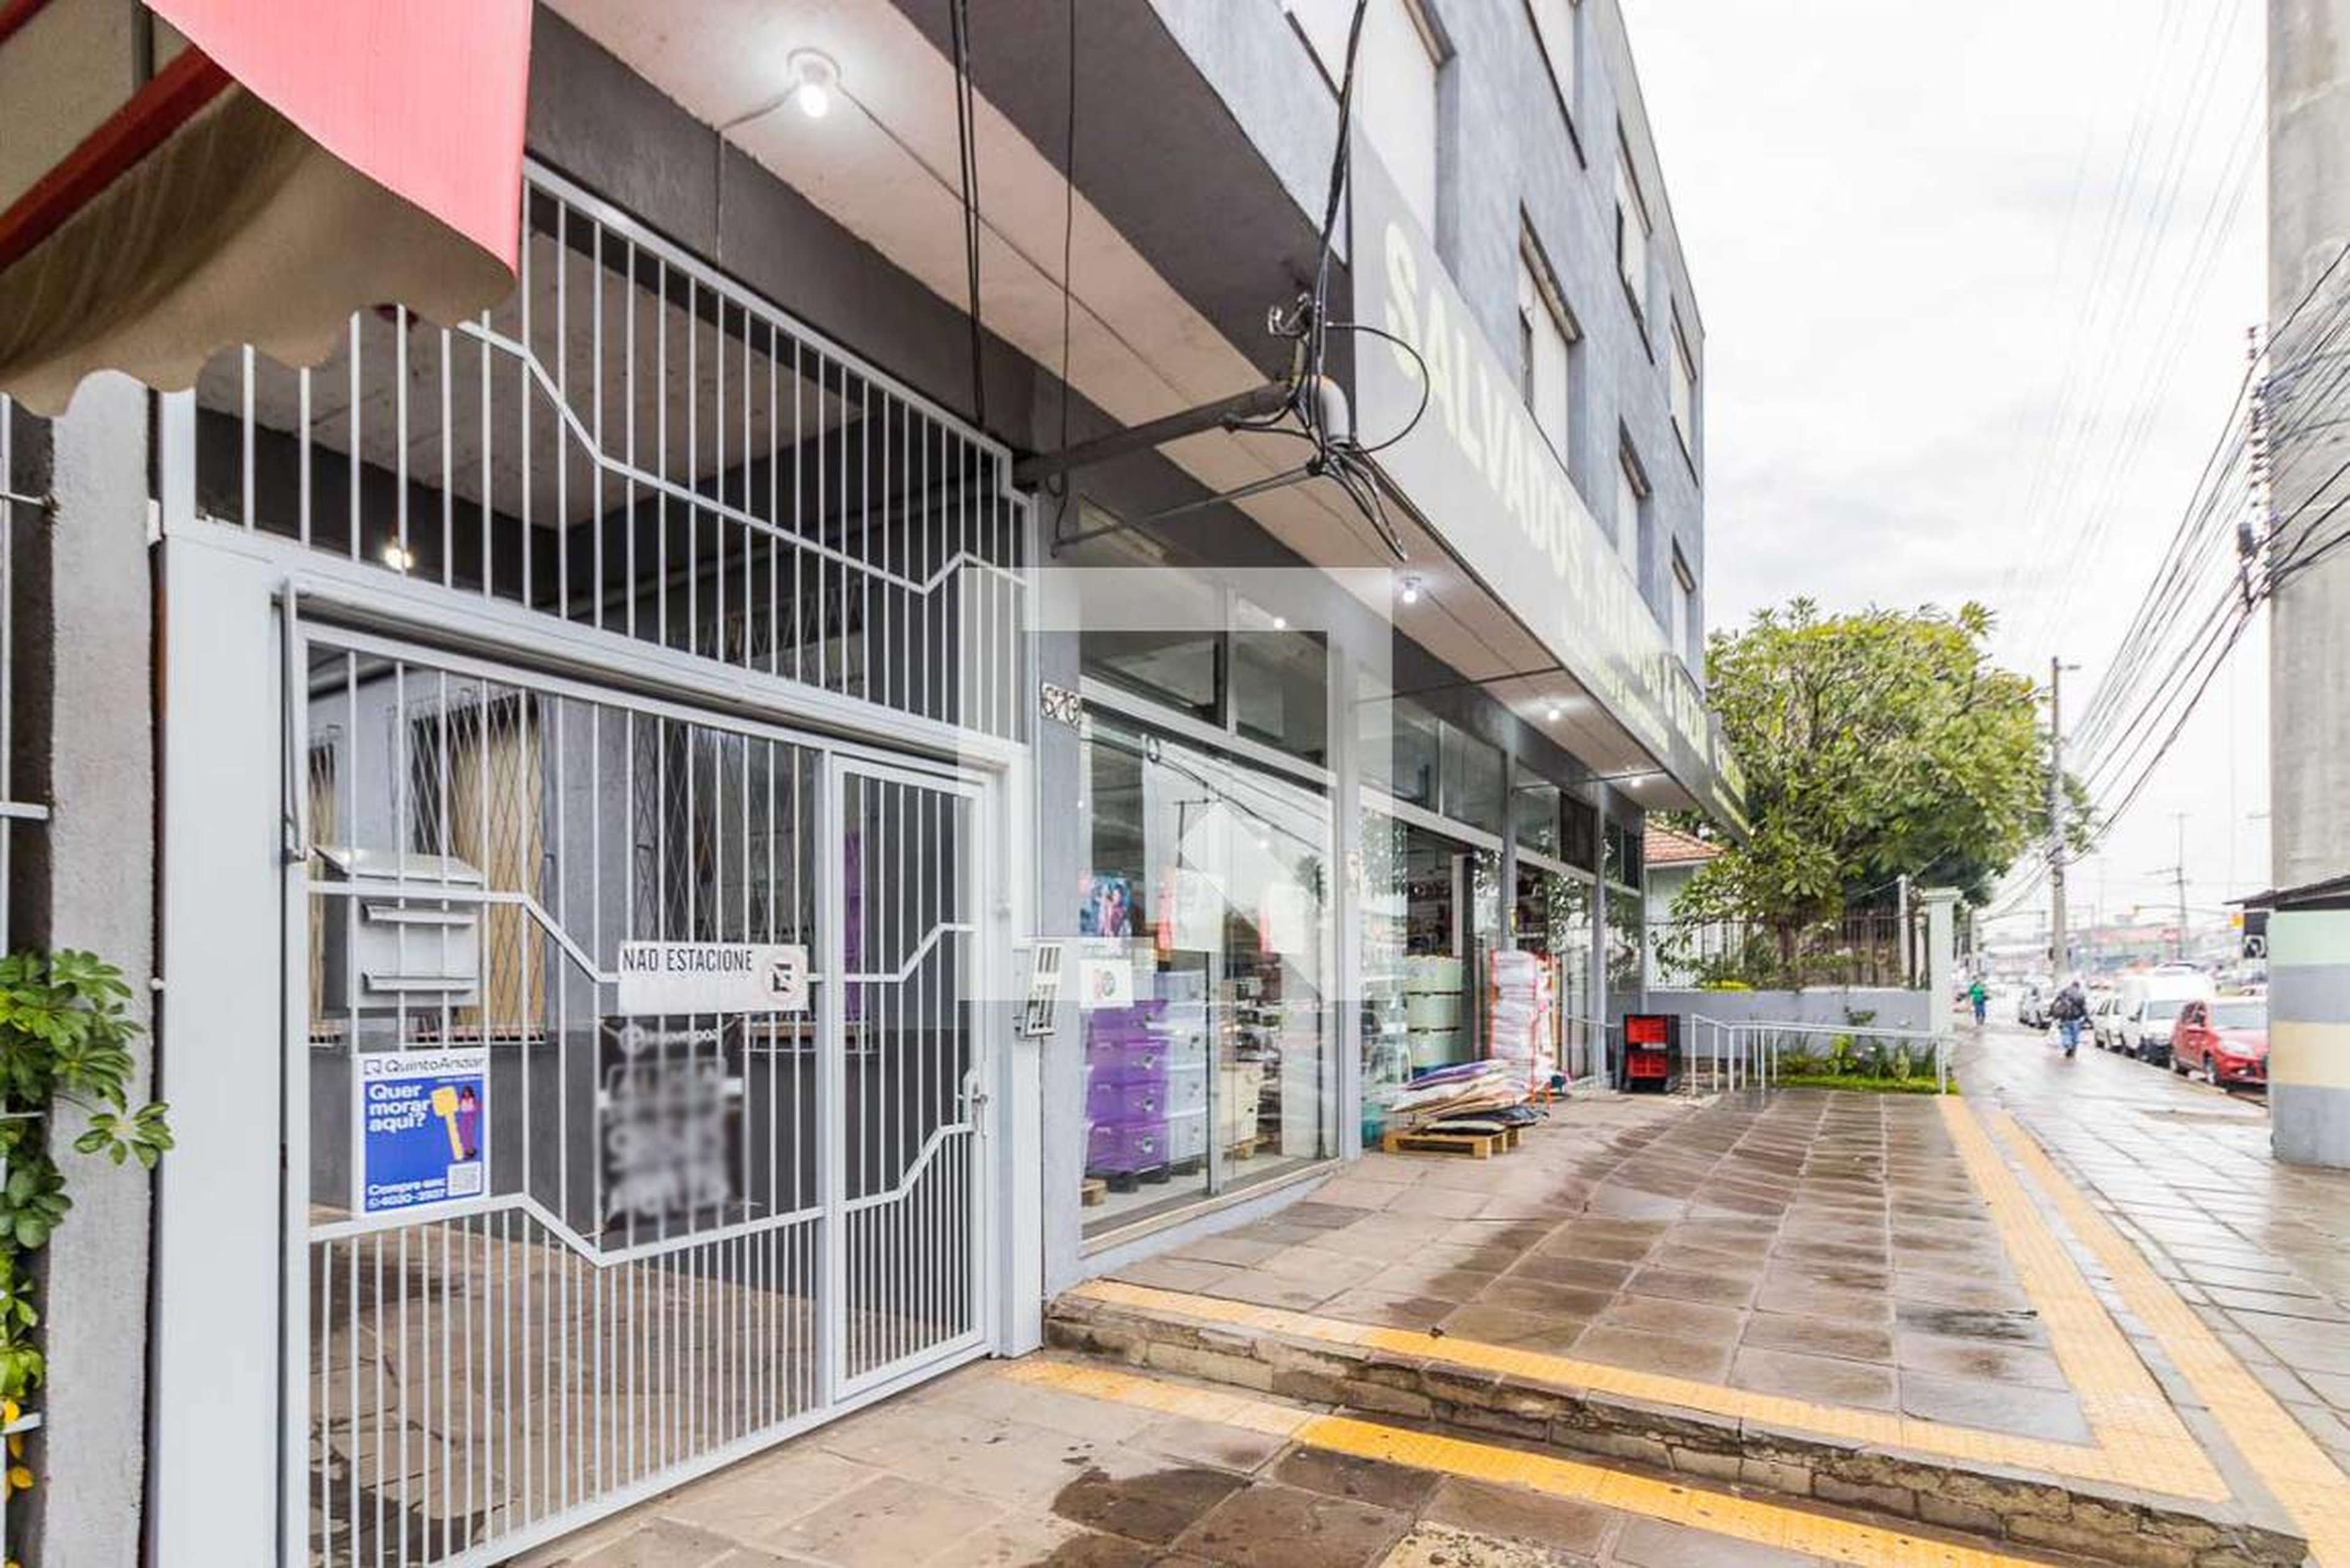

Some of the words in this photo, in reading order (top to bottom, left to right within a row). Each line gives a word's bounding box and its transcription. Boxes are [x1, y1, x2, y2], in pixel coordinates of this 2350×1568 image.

[668, 949, 752, 972] ESTACIONE
[370, 1083, 422, 1100] Quer
[368, 1111, 426, 1133] aqui?
